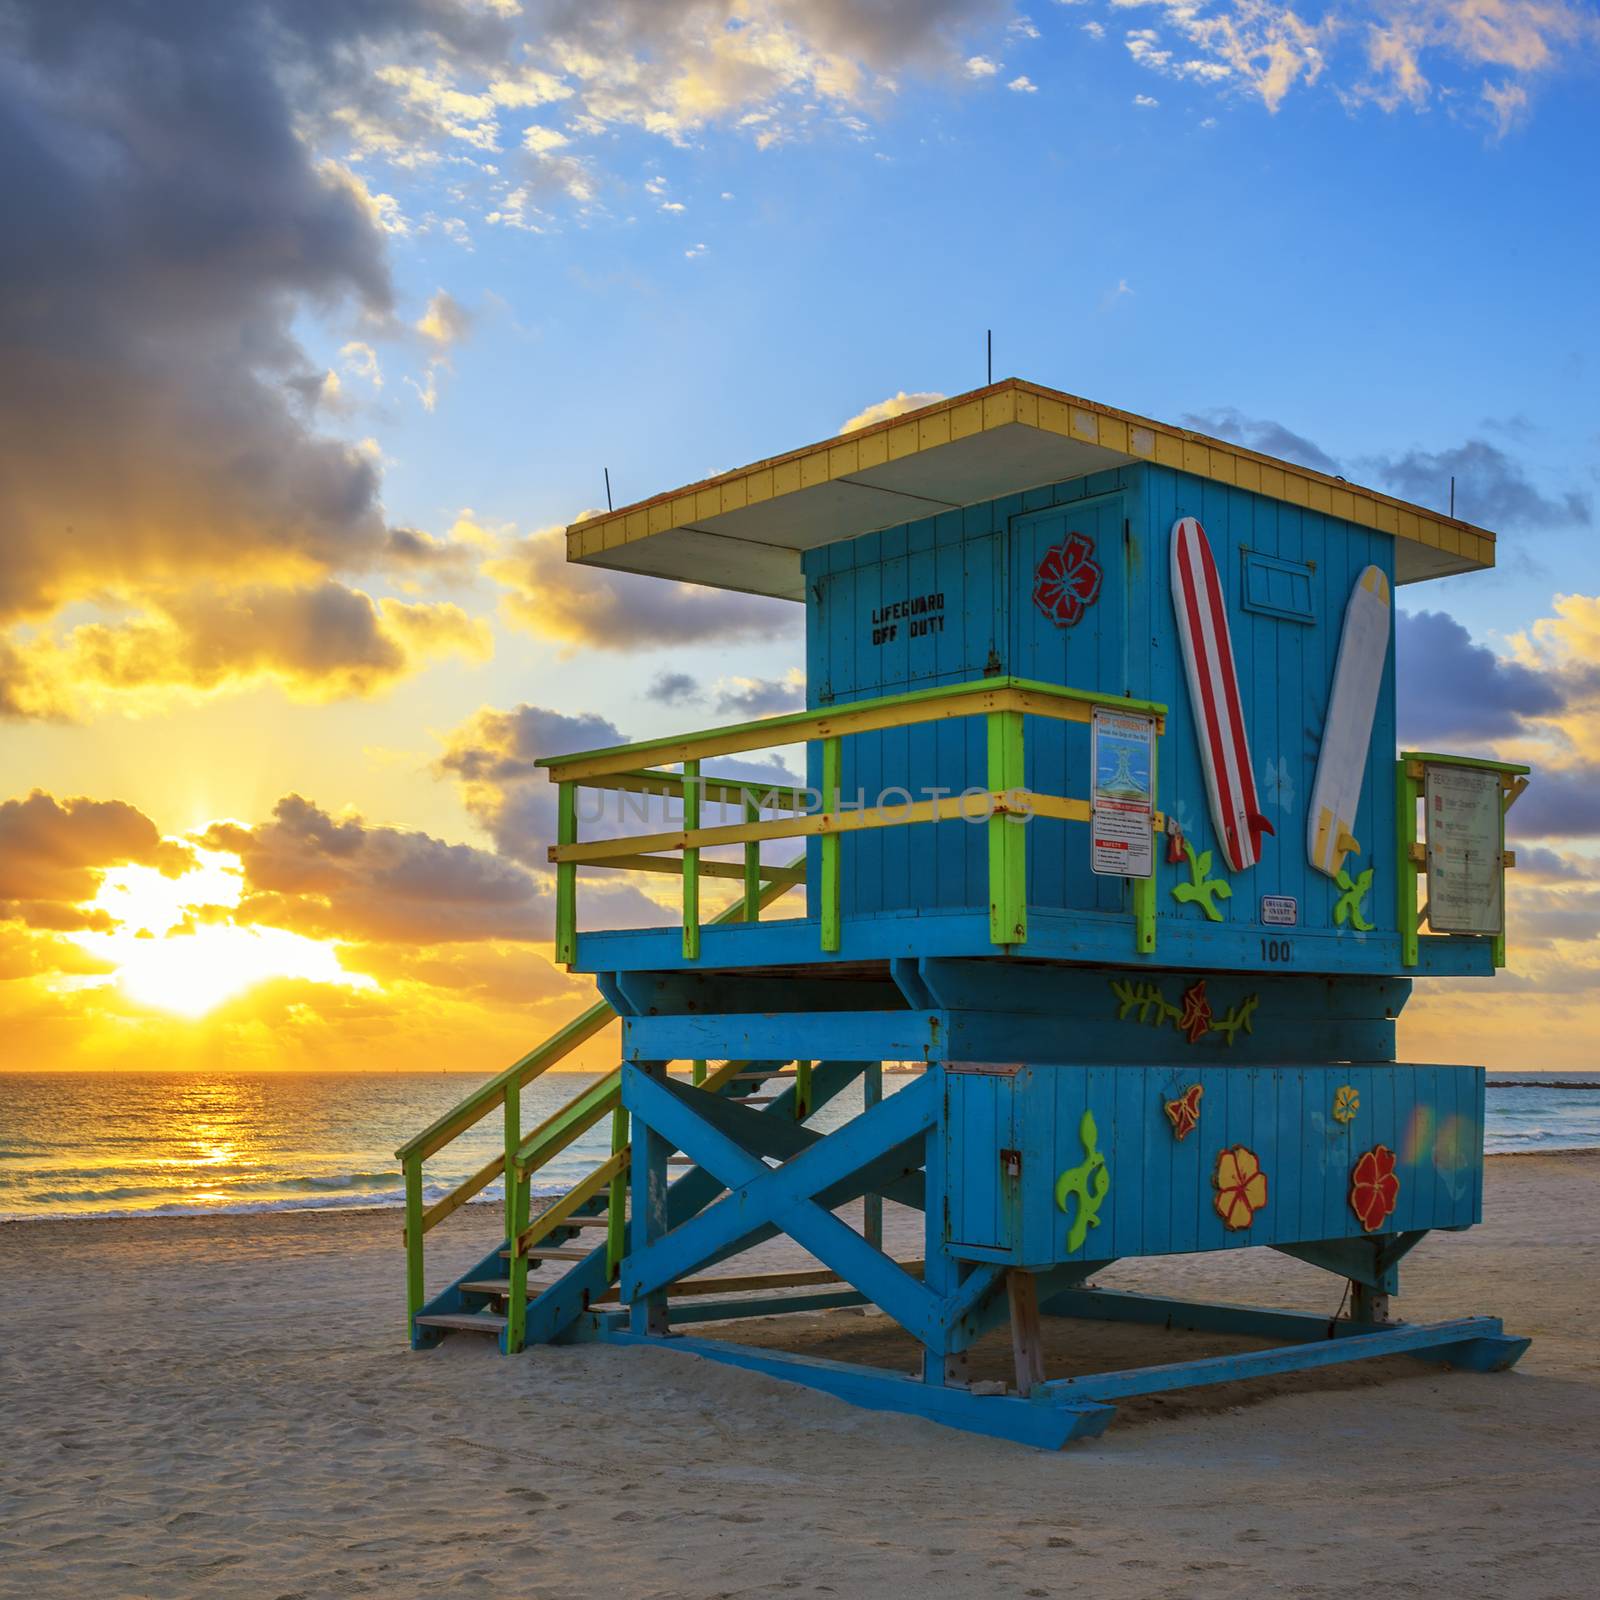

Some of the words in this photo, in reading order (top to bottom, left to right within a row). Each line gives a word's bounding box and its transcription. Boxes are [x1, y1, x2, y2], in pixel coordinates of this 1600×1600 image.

[872, 593, 944, 624] LIFEGUARD
[873, 625, 897, 646] OFF
[911, 615, 944, 637] DUTY
